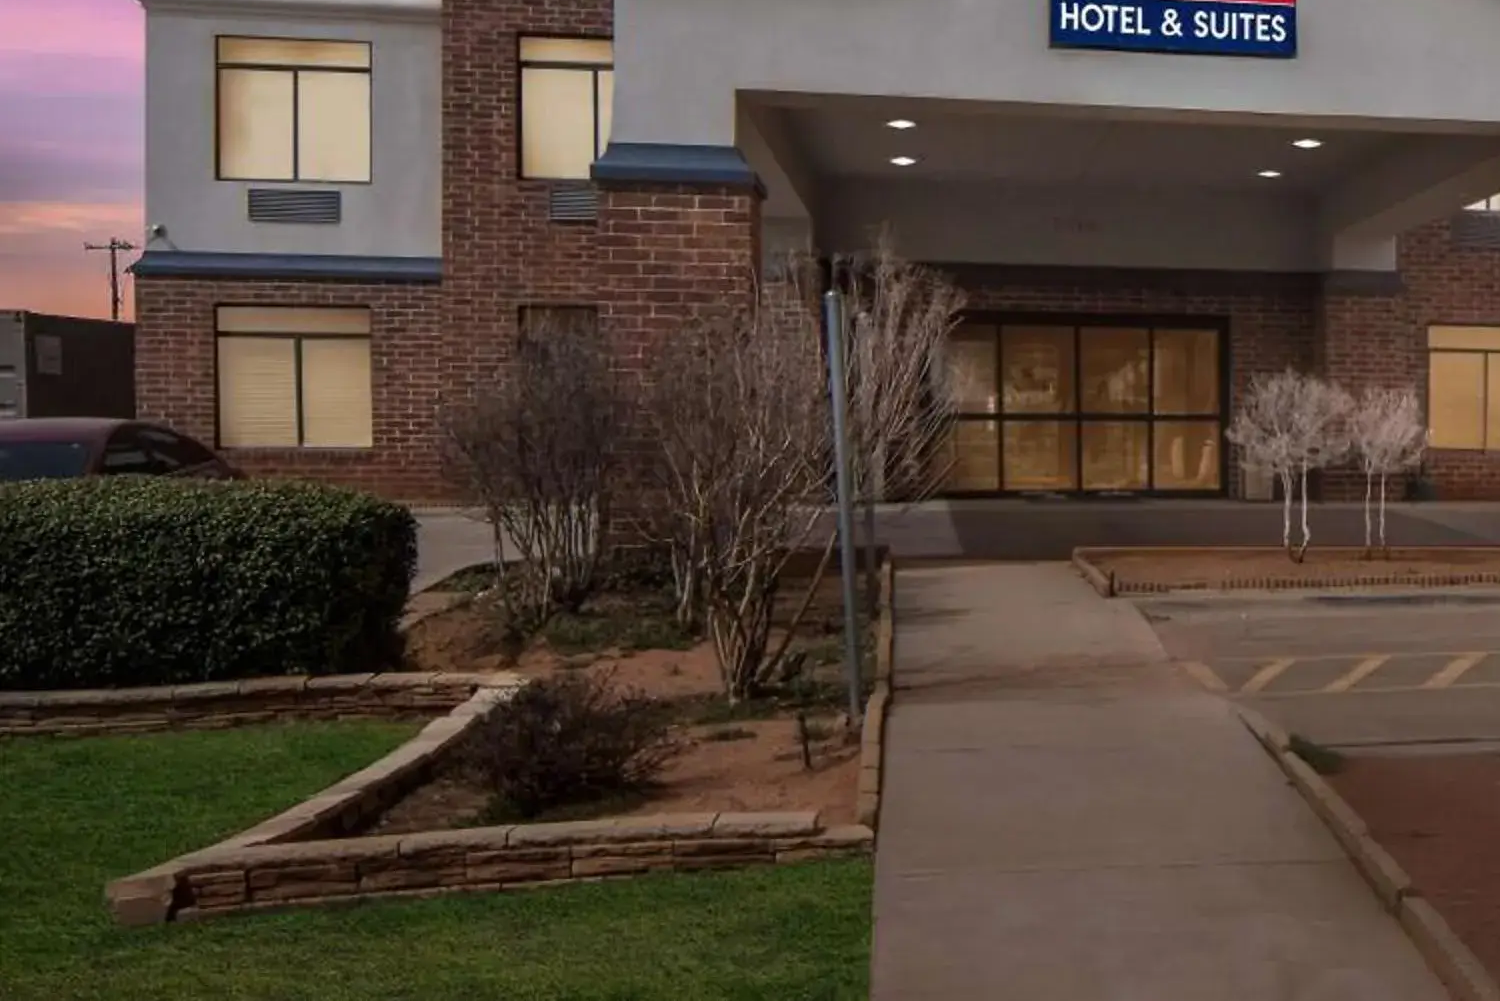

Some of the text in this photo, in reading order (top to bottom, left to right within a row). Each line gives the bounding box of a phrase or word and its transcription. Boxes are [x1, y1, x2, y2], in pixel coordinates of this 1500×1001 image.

[1060, 1, 1287, 42] HOTEL & SUITES
